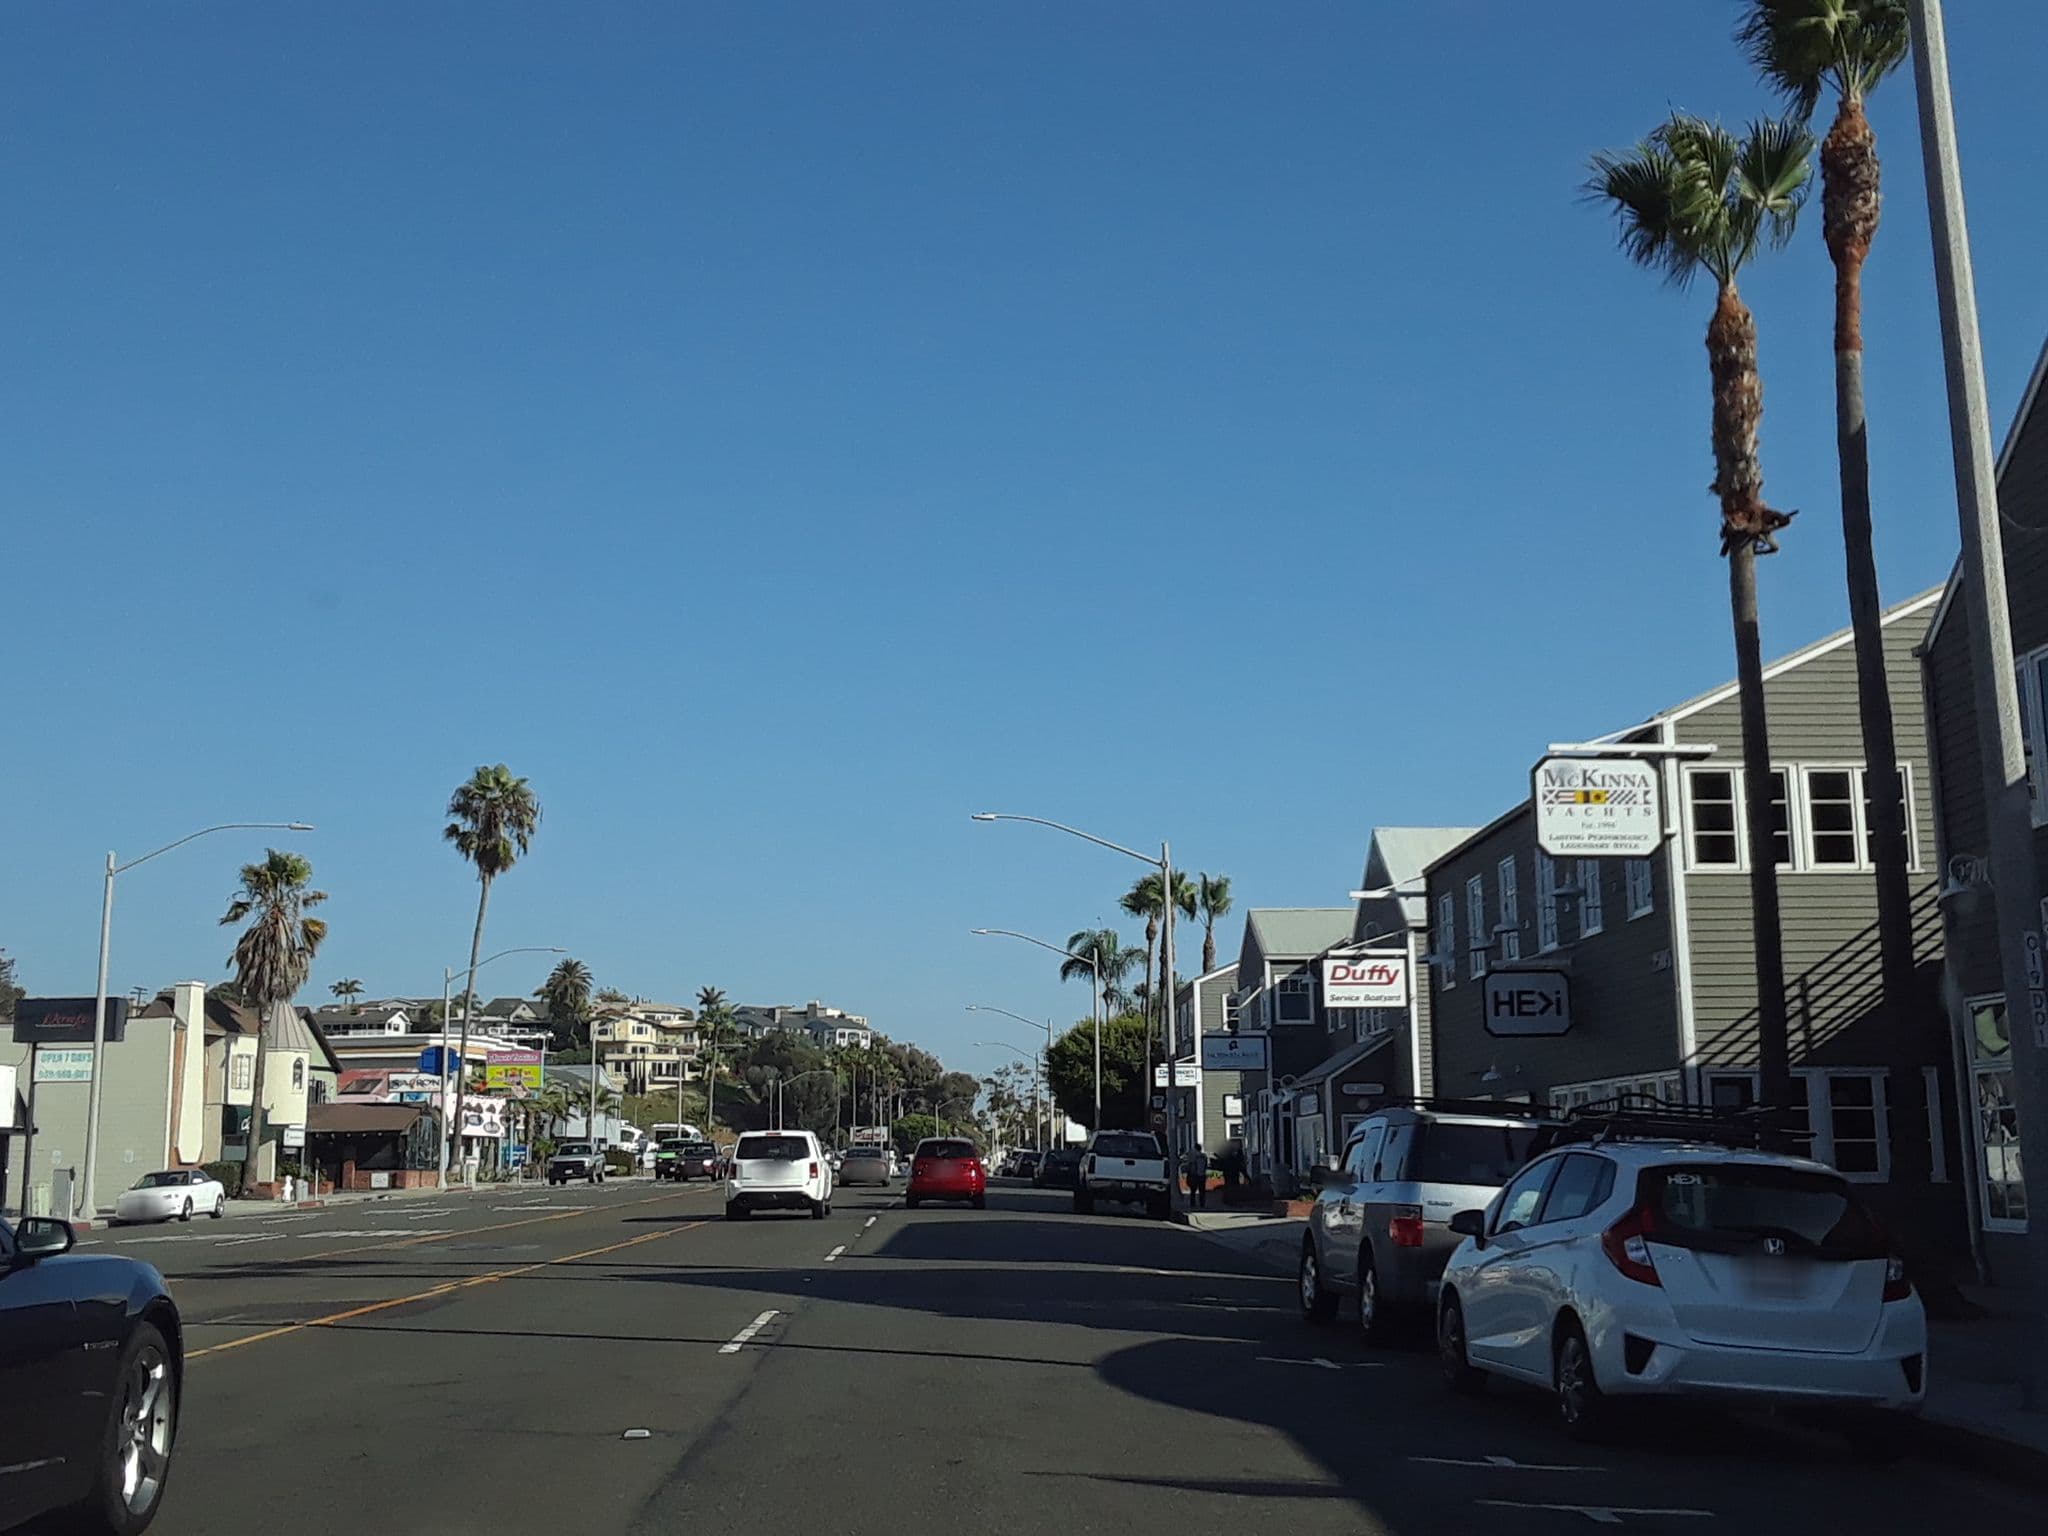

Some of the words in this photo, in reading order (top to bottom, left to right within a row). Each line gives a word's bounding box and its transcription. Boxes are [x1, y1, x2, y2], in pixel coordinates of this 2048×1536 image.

[1546, 807, 1652, 817] YACHTS
[1328, 964, 1400, 986] Duffy
[1329, 994, 1360, 1002] Service
[1363, 994, 1401, 1002] Boatyard
[40, 1052, 62, 1063] OPEN
[71, 1052, 92, 1062] DAYS
